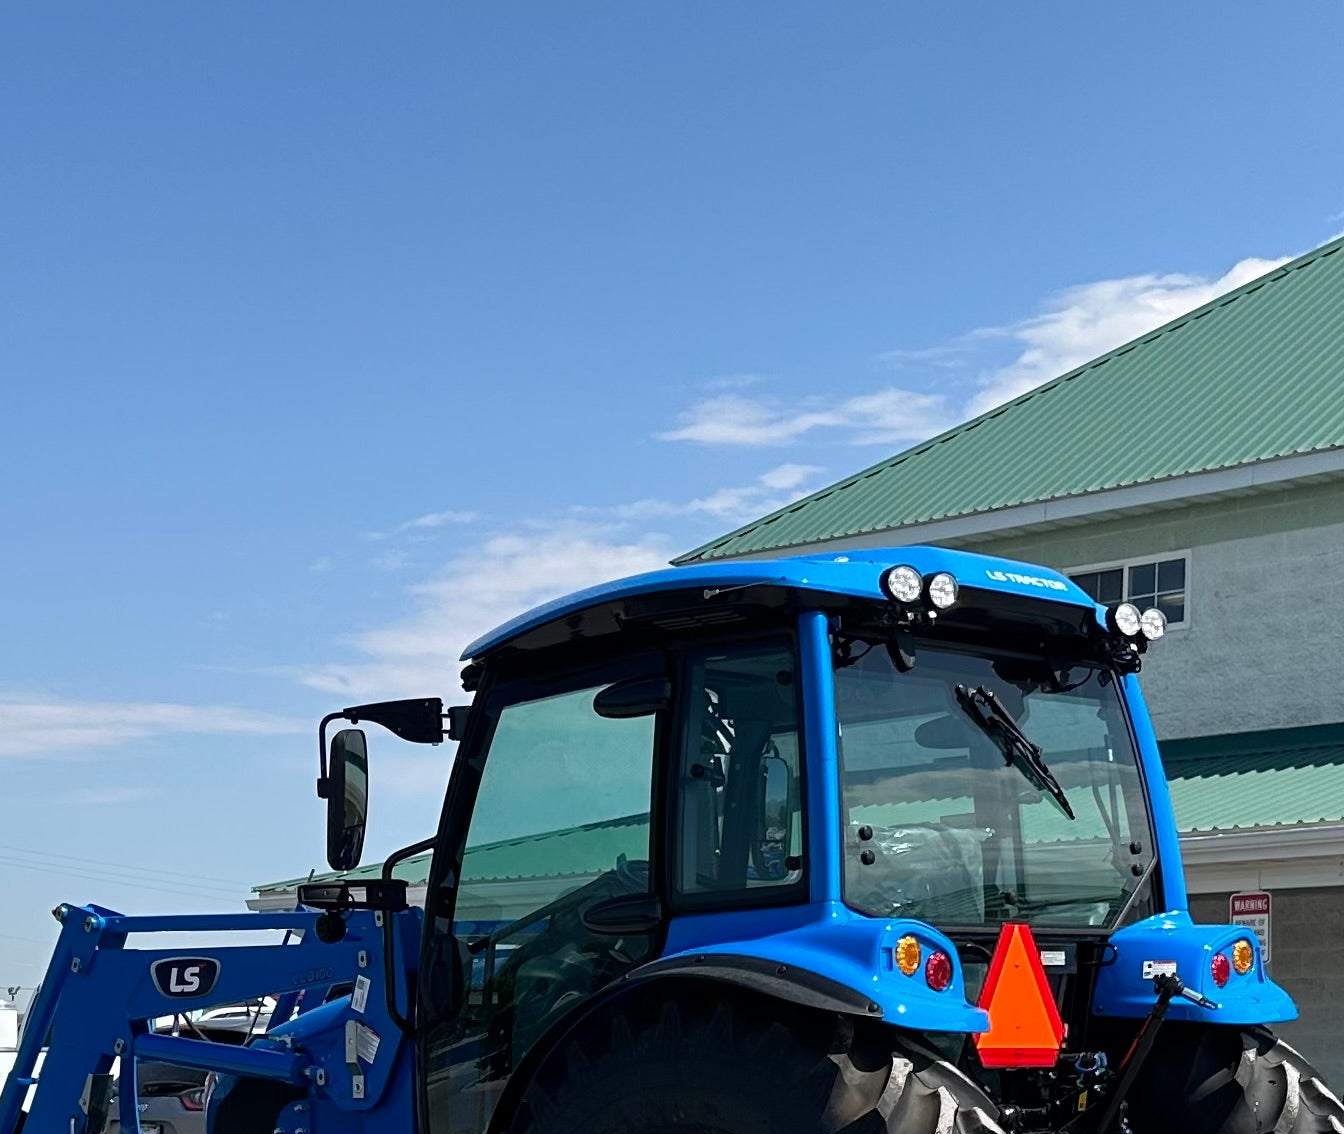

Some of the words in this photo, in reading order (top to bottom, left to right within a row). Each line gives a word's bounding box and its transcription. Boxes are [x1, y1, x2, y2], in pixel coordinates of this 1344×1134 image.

[985, 569, 1008, 582] LS
[1005, 572, 1069, 592] TRACTOR
[1233, 898, 1268, 912] WARNING
[169, 966, 200, 993] LS
